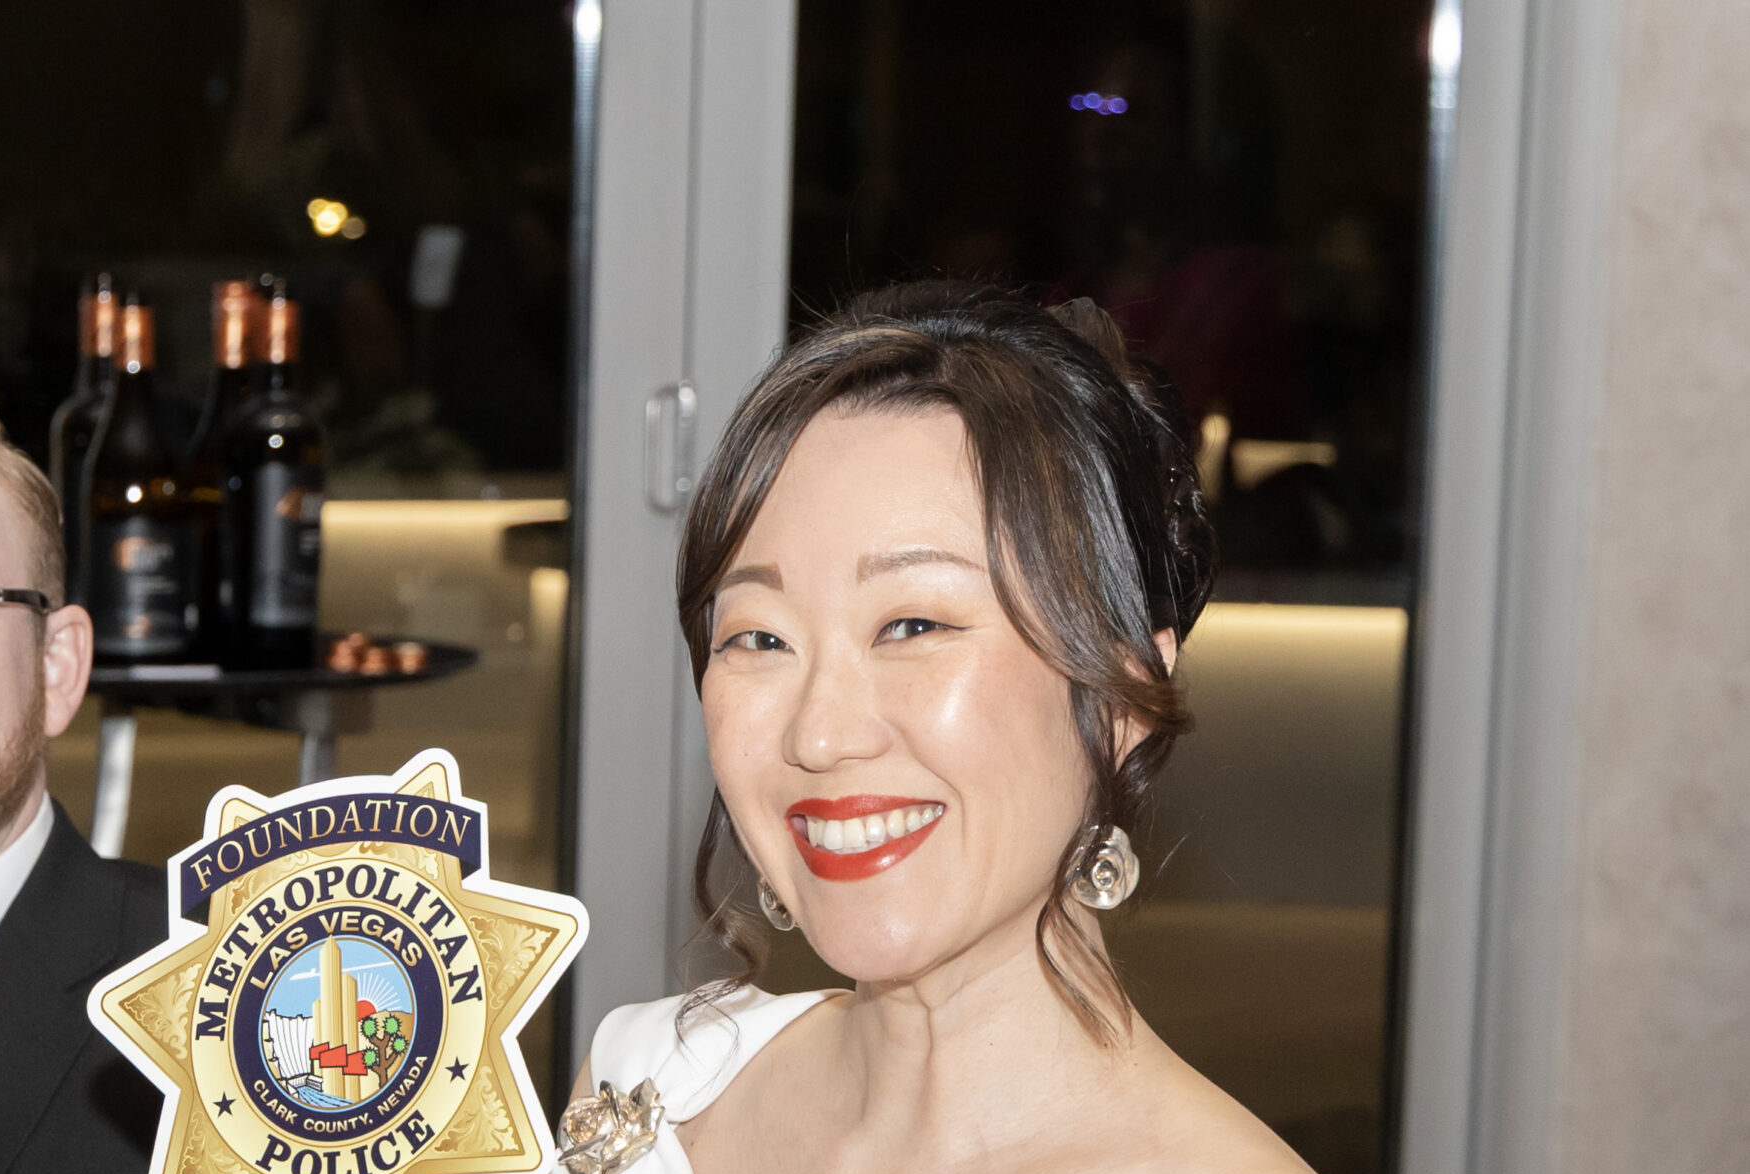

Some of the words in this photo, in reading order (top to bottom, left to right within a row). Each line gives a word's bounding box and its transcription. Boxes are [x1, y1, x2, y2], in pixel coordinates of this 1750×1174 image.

[190, 799, 471, 891] FOUNDATION
[196, 864, 482, 1041] METROPOLITAN
[251, 927, 308, 991] LAS
[320, 911, 423, 968] VEGAS
[254, 1080, 298, 1124] CLARK
[303, 1113, 373, 1133] COUNTY,
[377, 1055, 428, 1116] NEVADA
